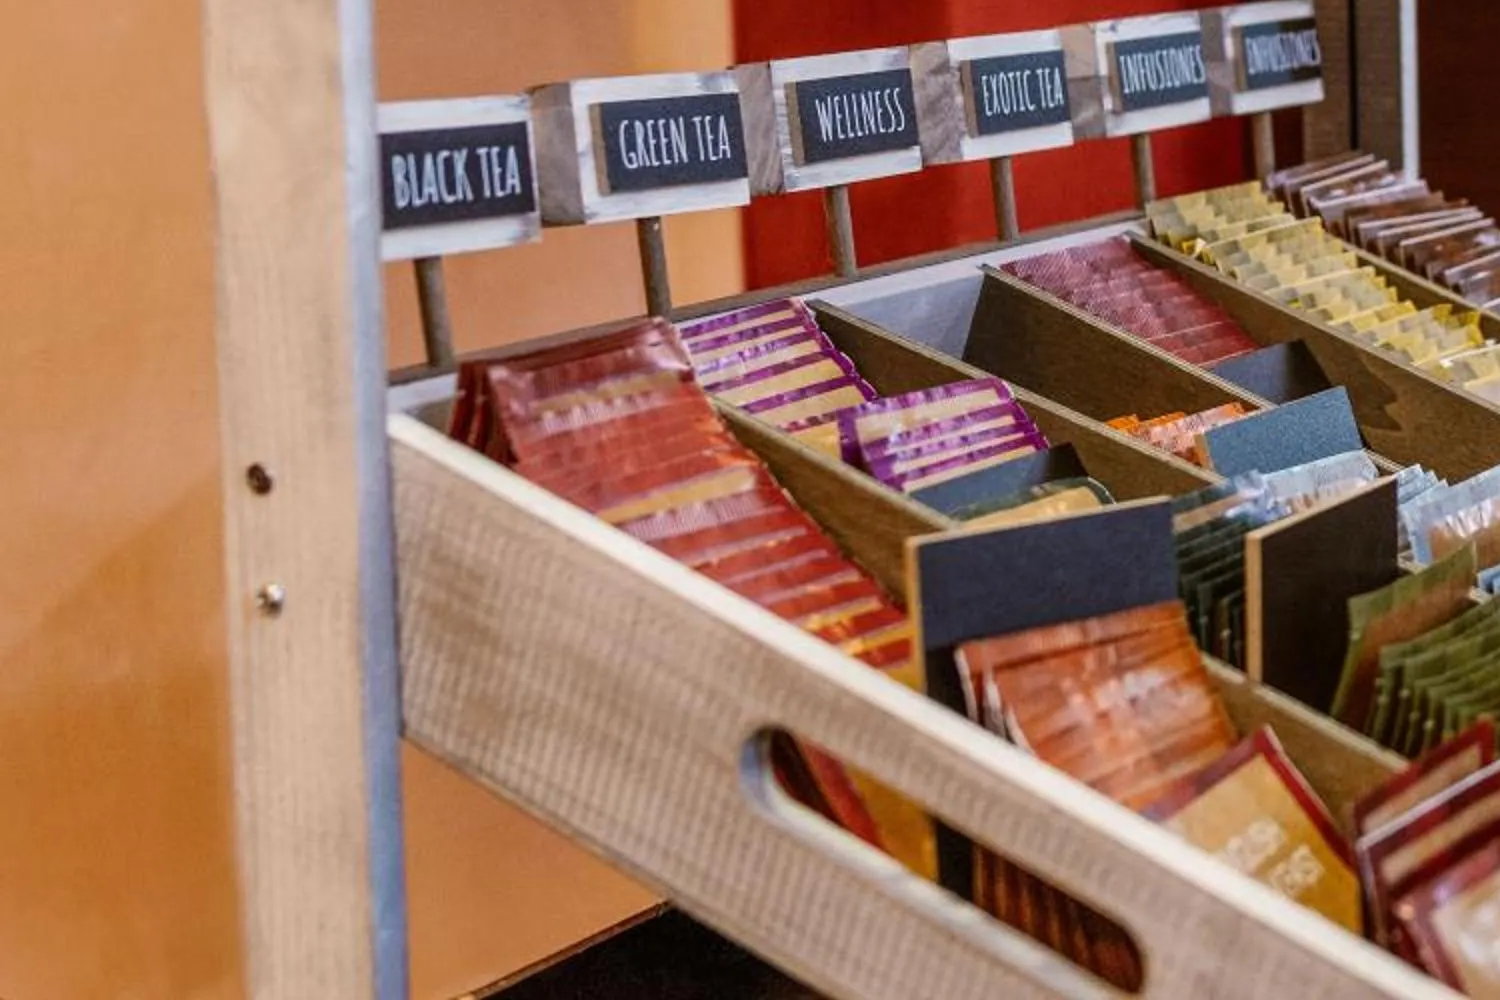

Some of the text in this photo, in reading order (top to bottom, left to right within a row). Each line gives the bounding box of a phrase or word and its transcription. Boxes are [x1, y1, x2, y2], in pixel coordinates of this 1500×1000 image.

[981, 66, 1065, 117] EXOTIC TEA
[1119, 45, 1207, 94] INFUSIONES
[618, 112, 732, 170] GREEN TEA
[815, 86, 906, 144] WELLNESS
[391, 144, 523, 209] BLACK TEA
